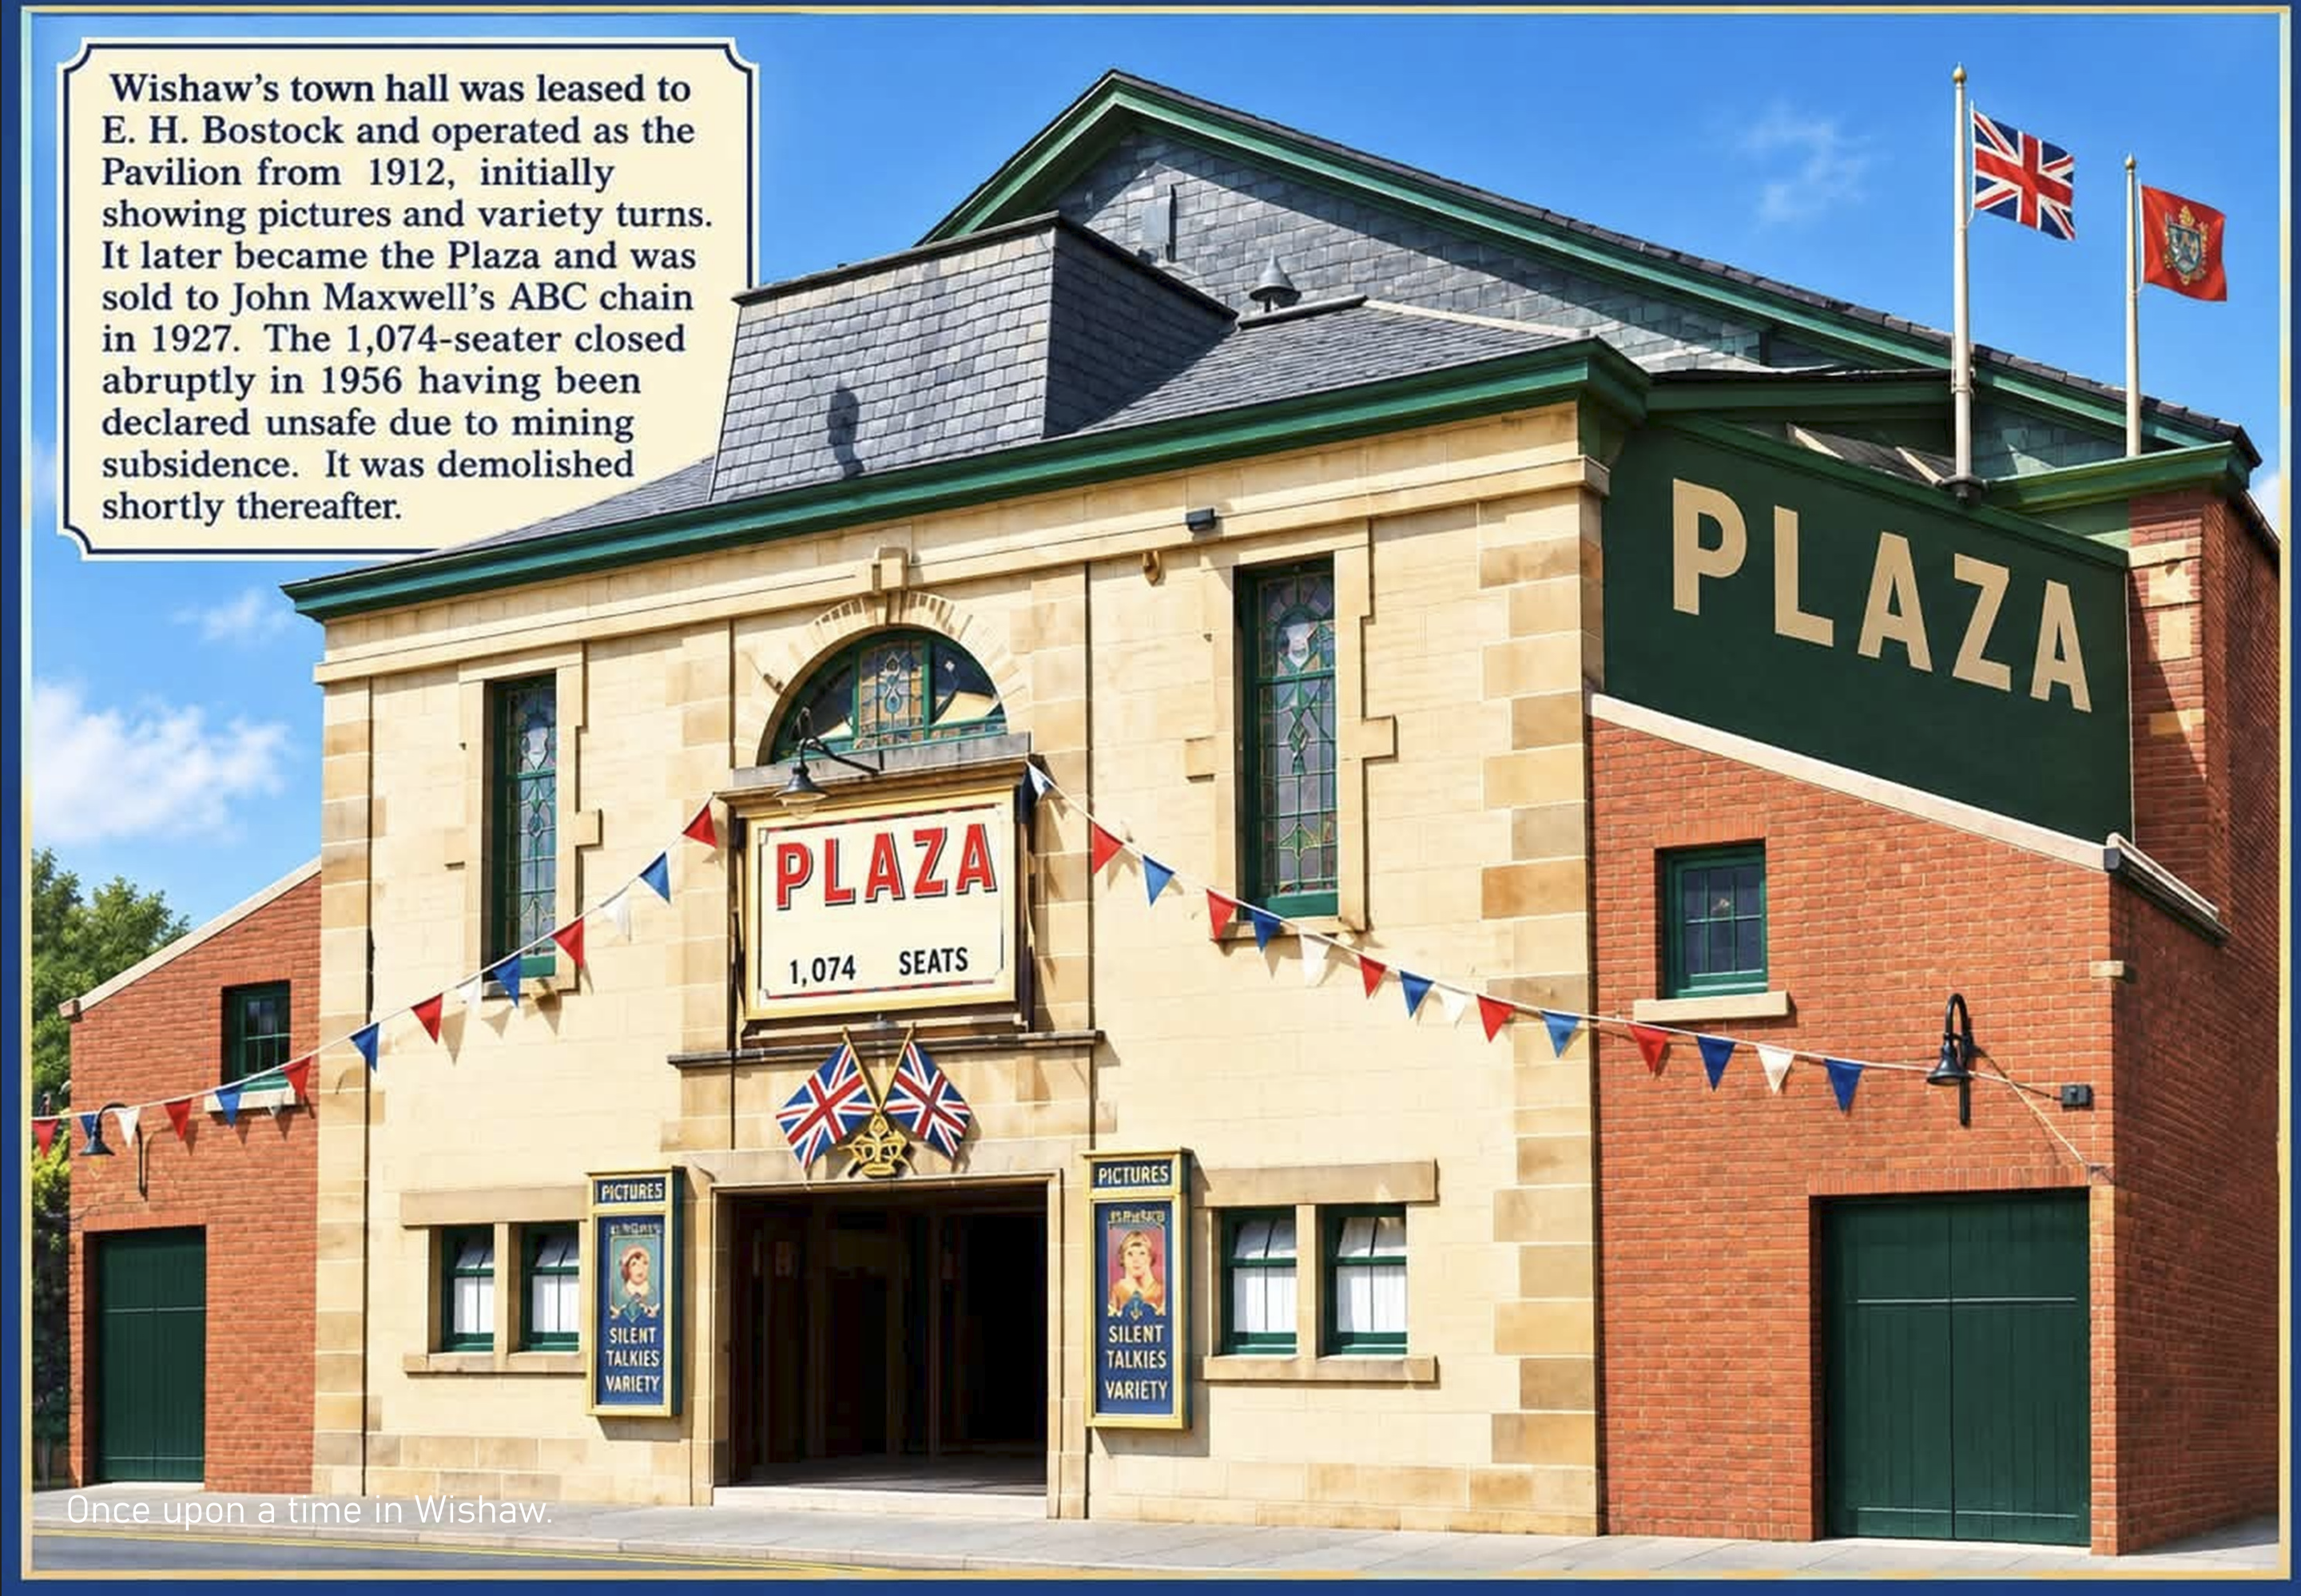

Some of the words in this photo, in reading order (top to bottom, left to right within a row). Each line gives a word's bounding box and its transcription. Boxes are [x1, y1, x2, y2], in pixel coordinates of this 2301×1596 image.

[1673, 478, 2092, 713] PLAZA
[776, 822, 998, 911] PLAZA
[789, 955, 857, 987] 1,074
[899, 947, 969, 977] SEATS
[1098, 1165, 1169, 1185] PICTURES
[601, 1182, 664, 1201] PICTURES
[609, 1327, 657, 1344] SILENT
[1108, 1324, 1164, 1343] SILENT
[606, 1350, 660, 1368] TALKIES
[1106, 1349, 1166, 1369] TALKIES
[605, 1374, 662, 1393] VARIETY
[1104, 1380, 1168, 1400] VARIETY
